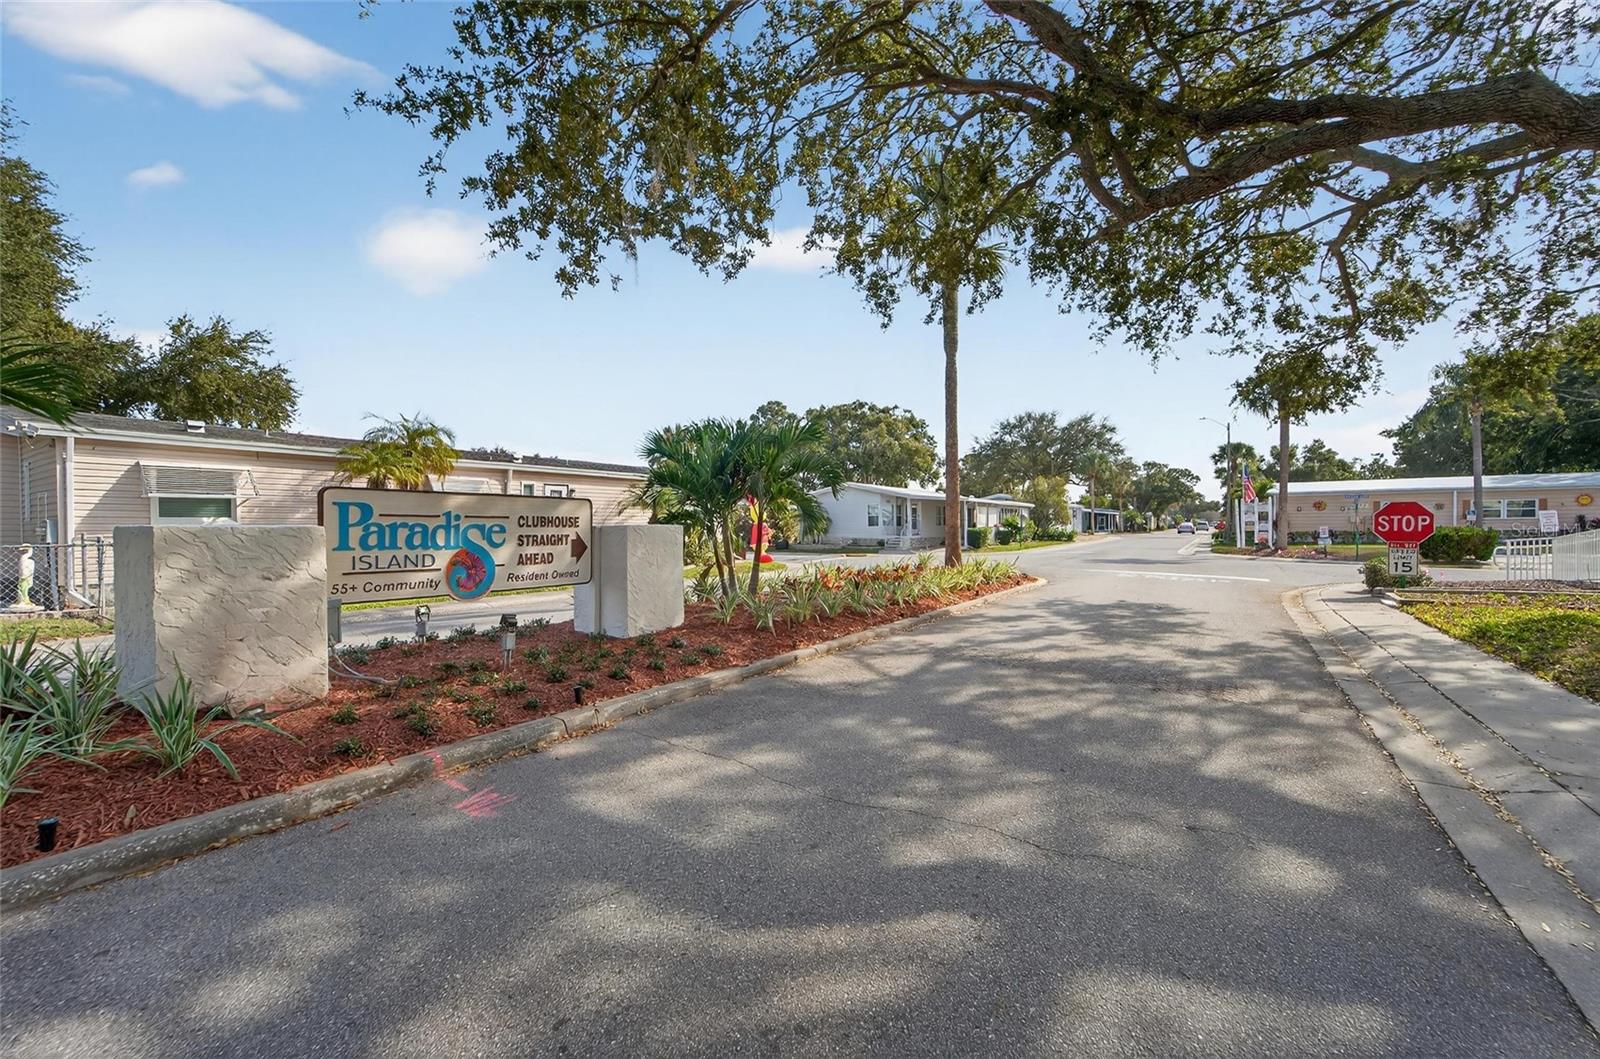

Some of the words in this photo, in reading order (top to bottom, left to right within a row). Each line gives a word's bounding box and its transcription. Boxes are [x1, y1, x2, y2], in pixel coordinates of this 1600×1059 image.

[332, 501, 506, 556] Paradise
[517, 515, 580, 529] CLUBHOUSE
[1377, 515, 1431, 532] STOP
[517, 534, 570, 547] STRAIGHT
[351, 553, 436, 571] ISLAND
[516, 552, 554, 566] AHEAD
[1393, 561, 1413, 573] 15
[506, 571, 549, 582] Resident
[551, 569, 579, 580] Owned
[330, 583, 358, 595] 55+
[363, 577, 441, 594] Community
